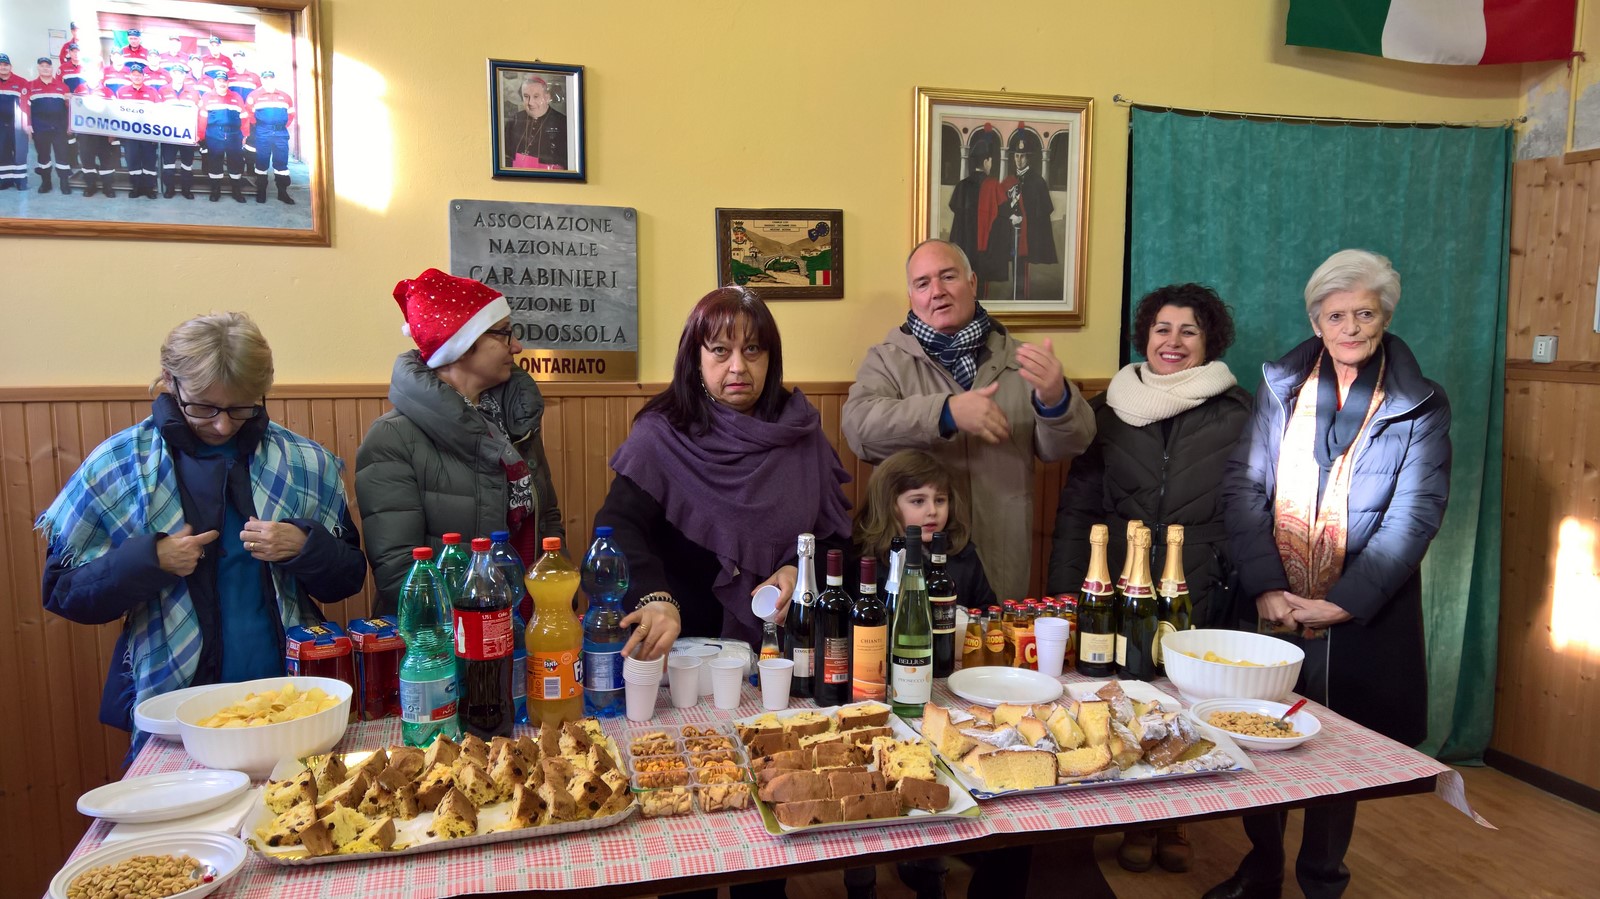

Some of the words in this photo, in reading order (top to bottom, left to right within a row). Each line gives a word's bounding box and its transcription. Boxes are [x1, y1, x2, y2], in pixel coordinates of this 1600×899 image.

[74, 114, 192, 140] DOMODOSSOLA
[473, 212, 614, 233] ASSOCIAZIONE
[488, 238, 600, 257] NAZIONALE
[469, 265, 617, 288] CARABINIERI
[505, 296, 572, 312] EZIONE
[579, 298, 596, 313] DI
[512, 322, 627, 344] ODOSSOLA
[519, 357, 606, 375] ONTARIATO
[543, 660, 559, 668] FANTA
